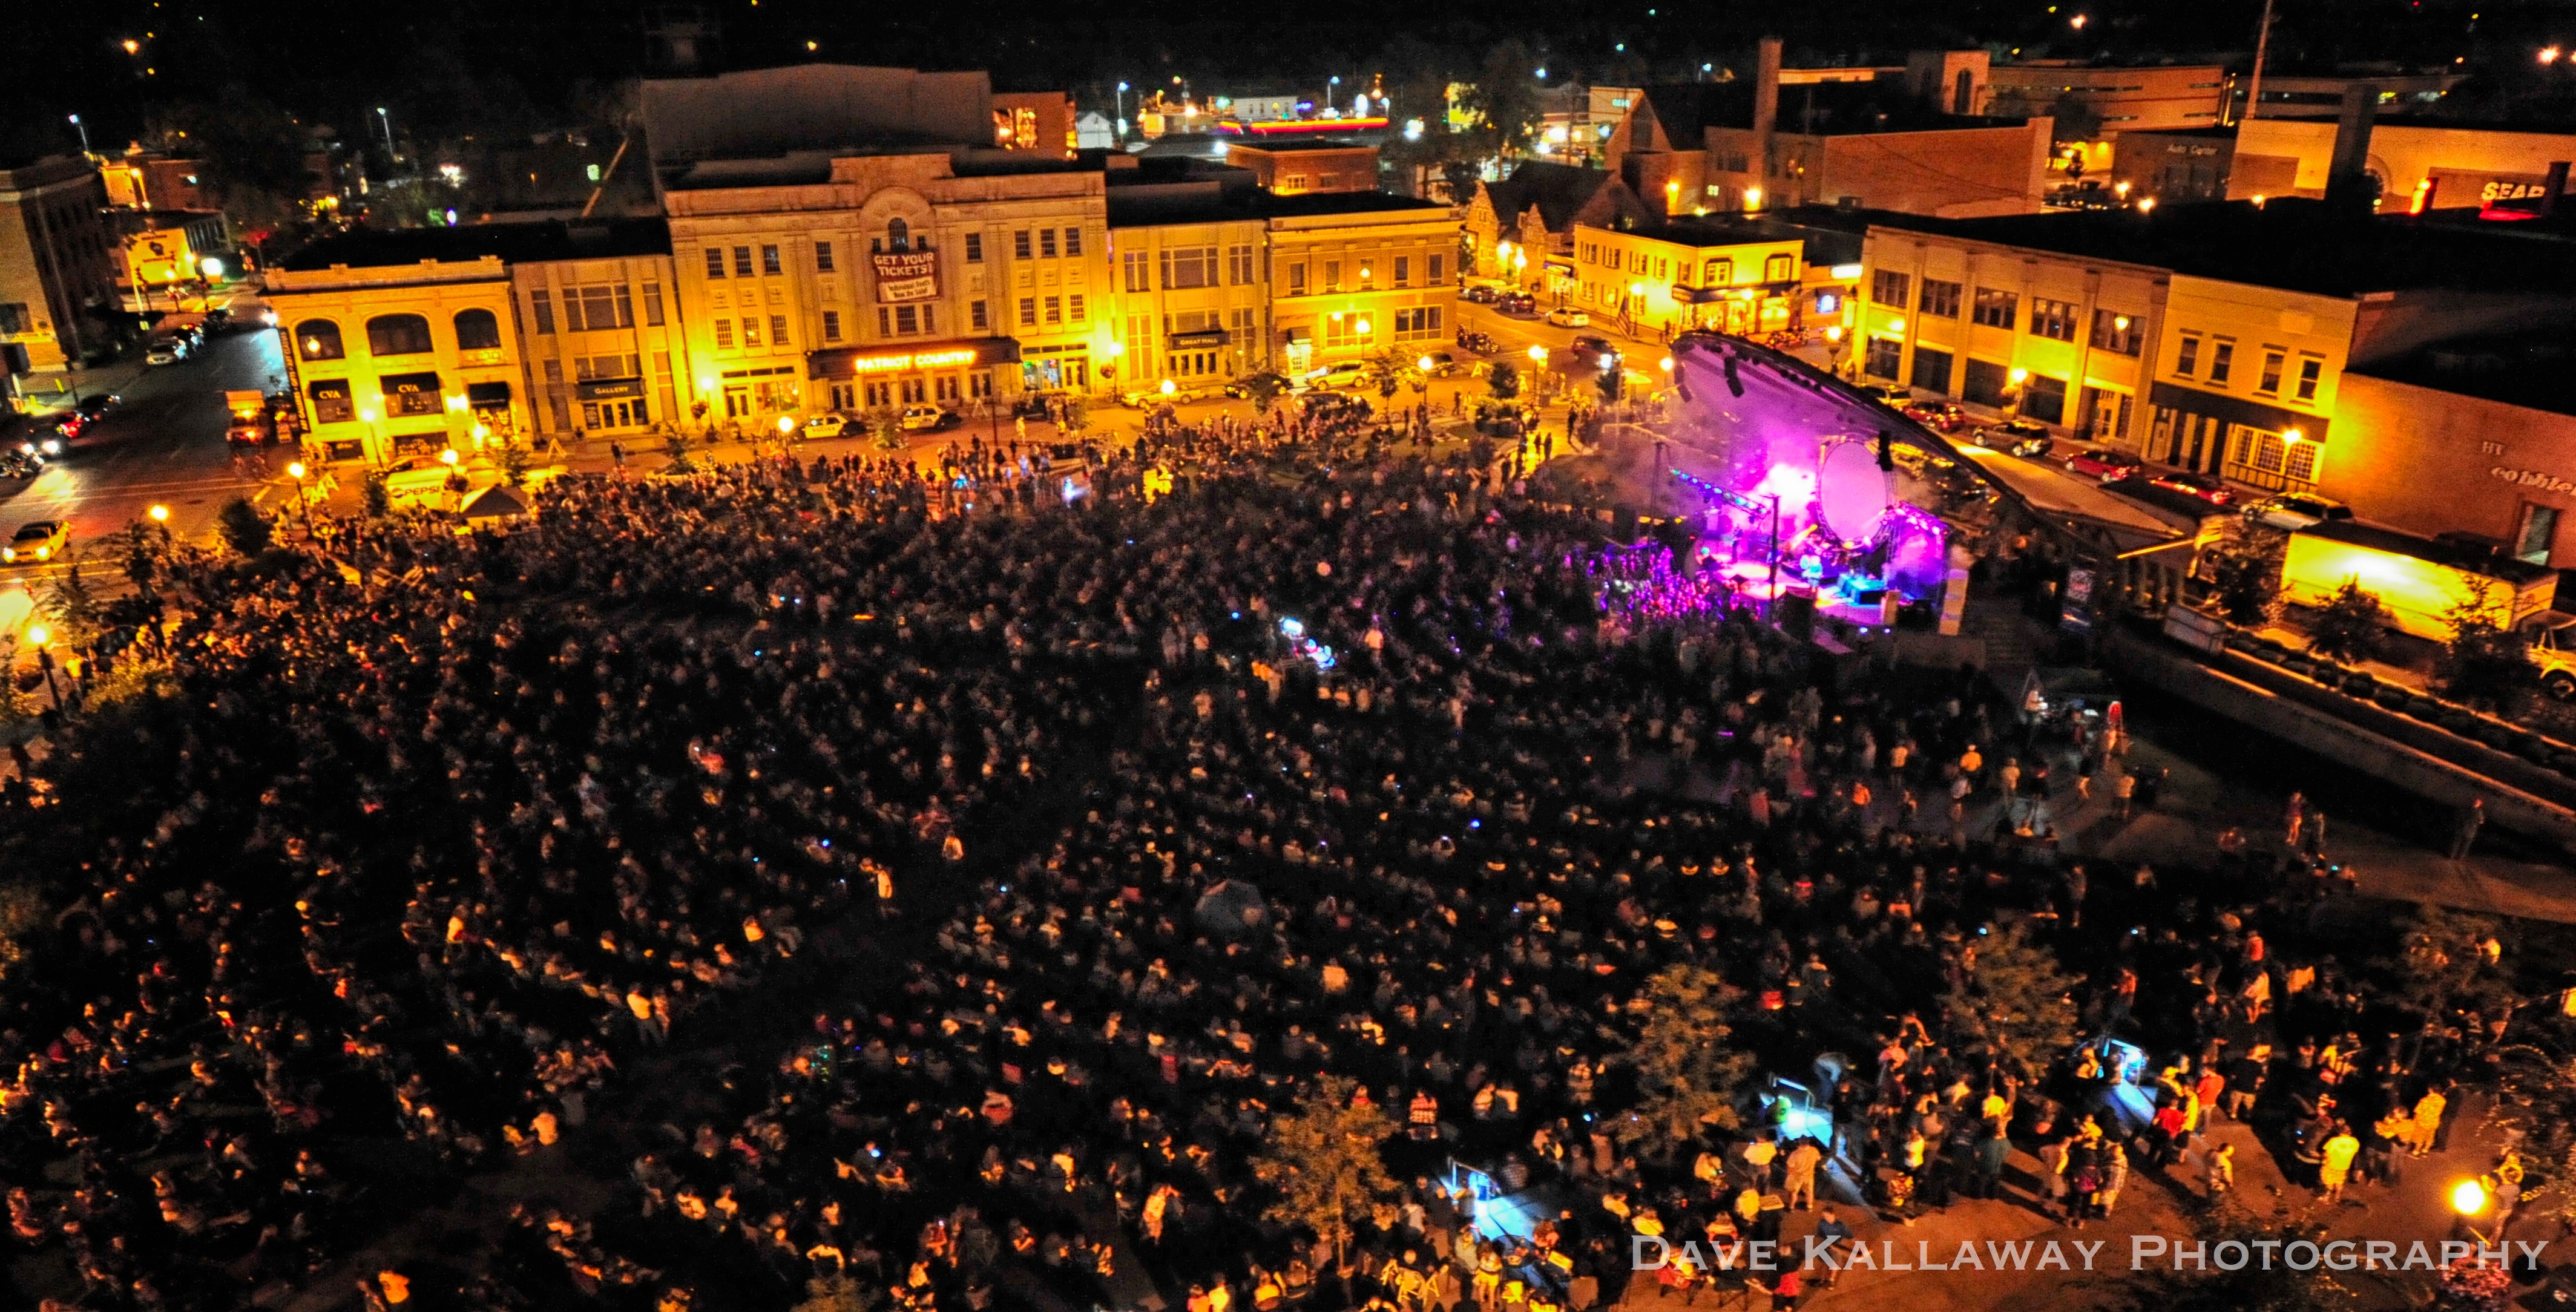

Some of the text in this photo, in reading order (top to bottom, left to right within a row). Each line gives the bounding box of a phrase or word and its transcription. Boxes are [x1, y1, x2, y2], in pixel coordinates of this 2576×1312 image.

[2481, 182, 2546, 200] SEAR
[873, 252, 934, 265] GET YOUR
[878, 262, 933, 276] TICKETS!
[855, 350, 976, 372] PATRIOT COUNTRY
[318, 390, 341, 399] CVA
[398, 384, 419, 393] CVA
[404, 486, 441, 496] PEPSI
